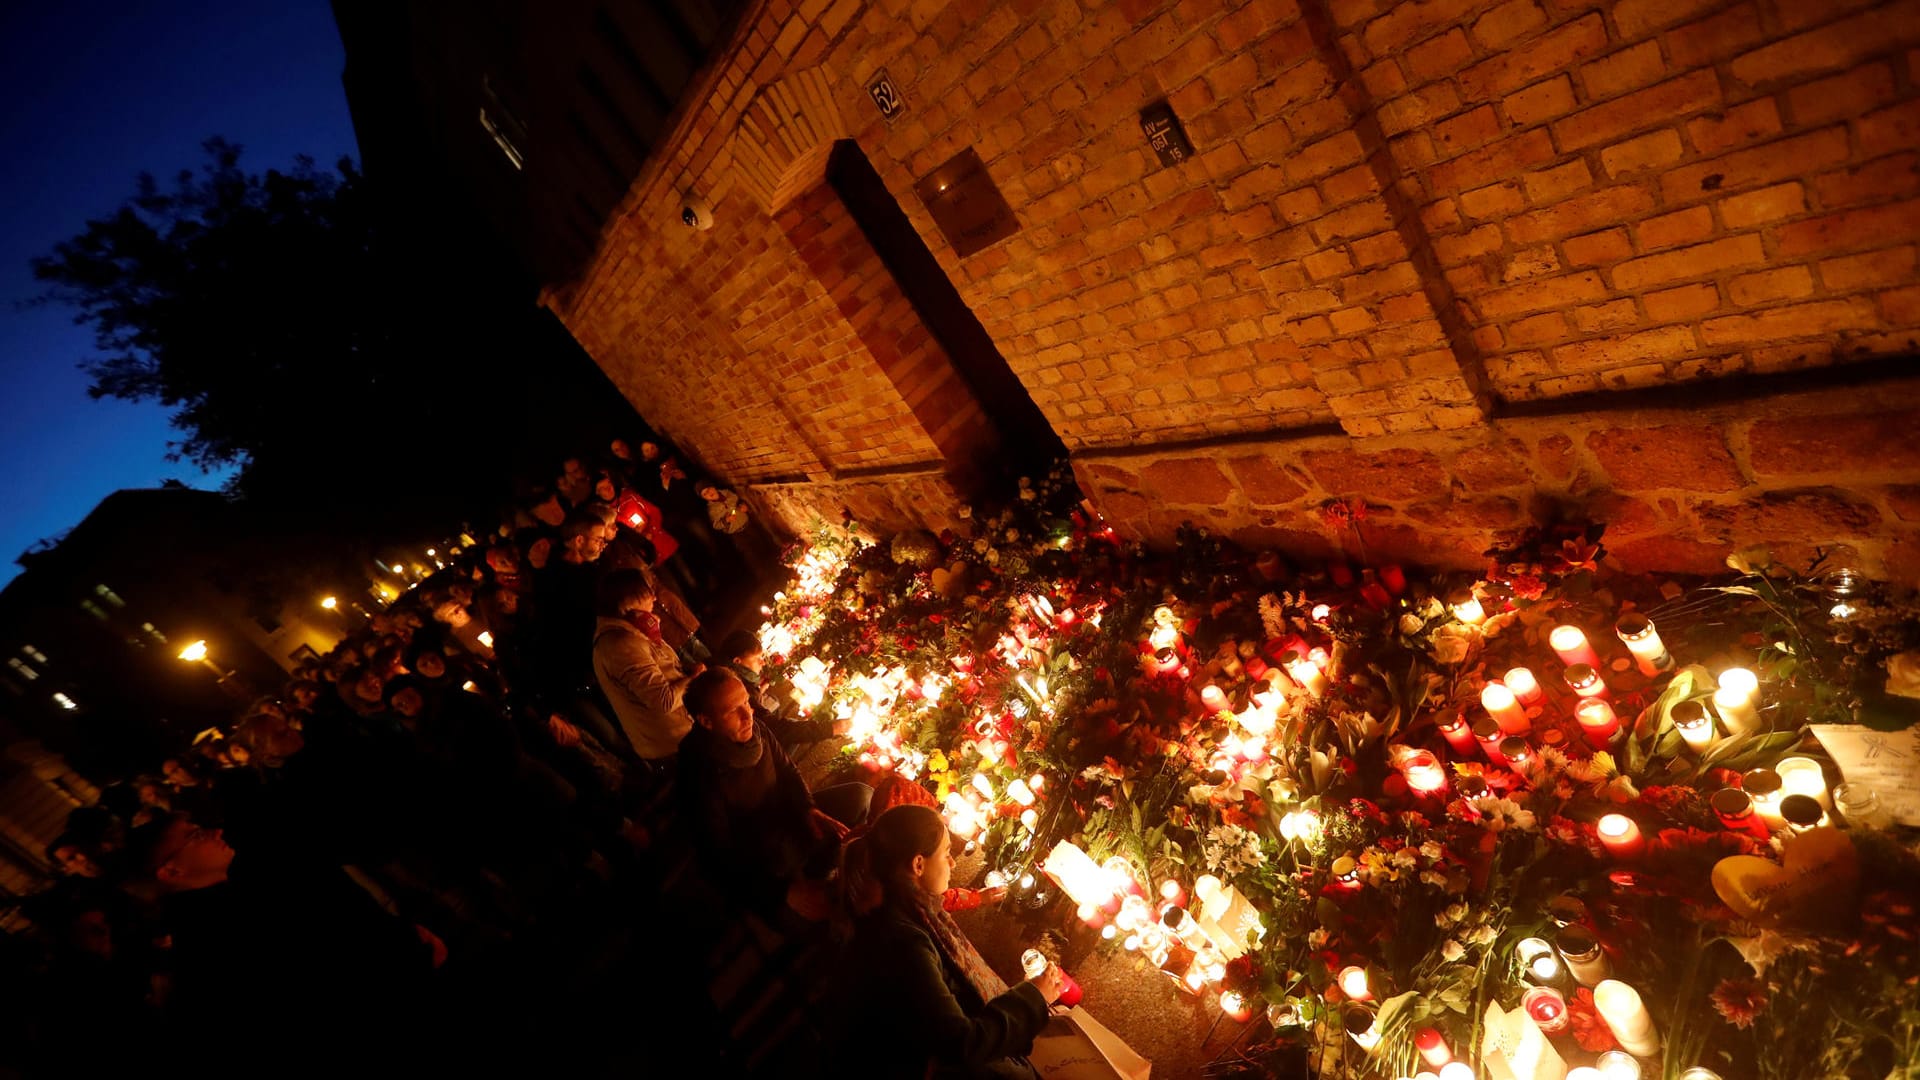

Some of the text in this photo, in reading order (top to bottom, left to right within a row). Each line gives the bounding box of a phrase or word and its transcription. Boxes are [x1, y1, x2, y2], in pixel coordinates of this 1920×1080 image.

[873, 82, 899, 114] 52
[1144, 121, 1157, 136] AV
[1169, 147, 1183, 160] 15
